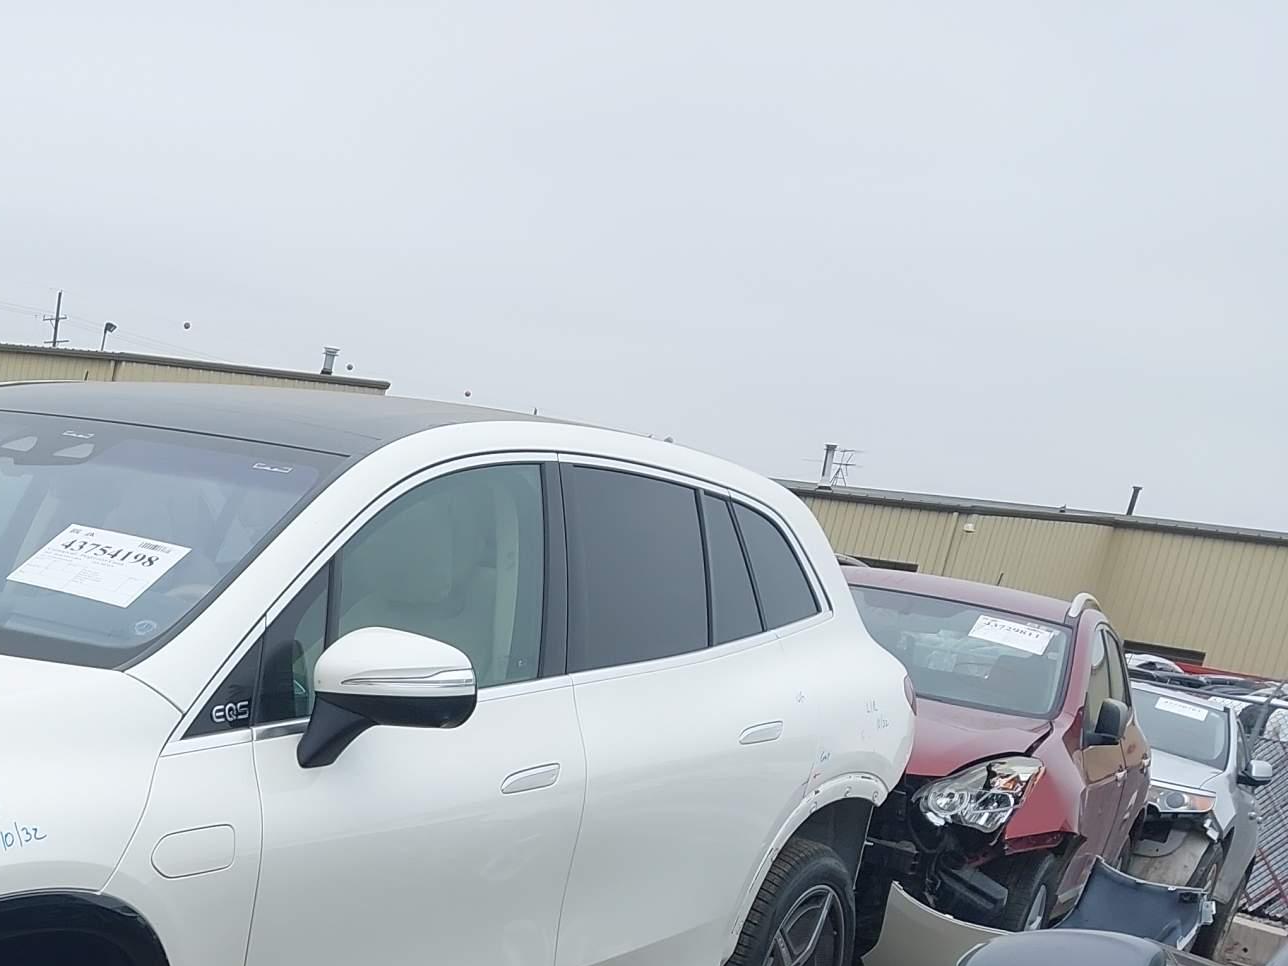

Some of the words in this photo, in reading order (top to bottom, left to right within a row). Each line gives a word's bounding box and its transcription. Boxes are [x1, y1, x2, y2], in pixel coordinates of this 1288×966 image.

[61, 539, 159, 567] 43754198
[212, 701, 250, 722] EQS
[0, 821, 47, 851] 10/32
